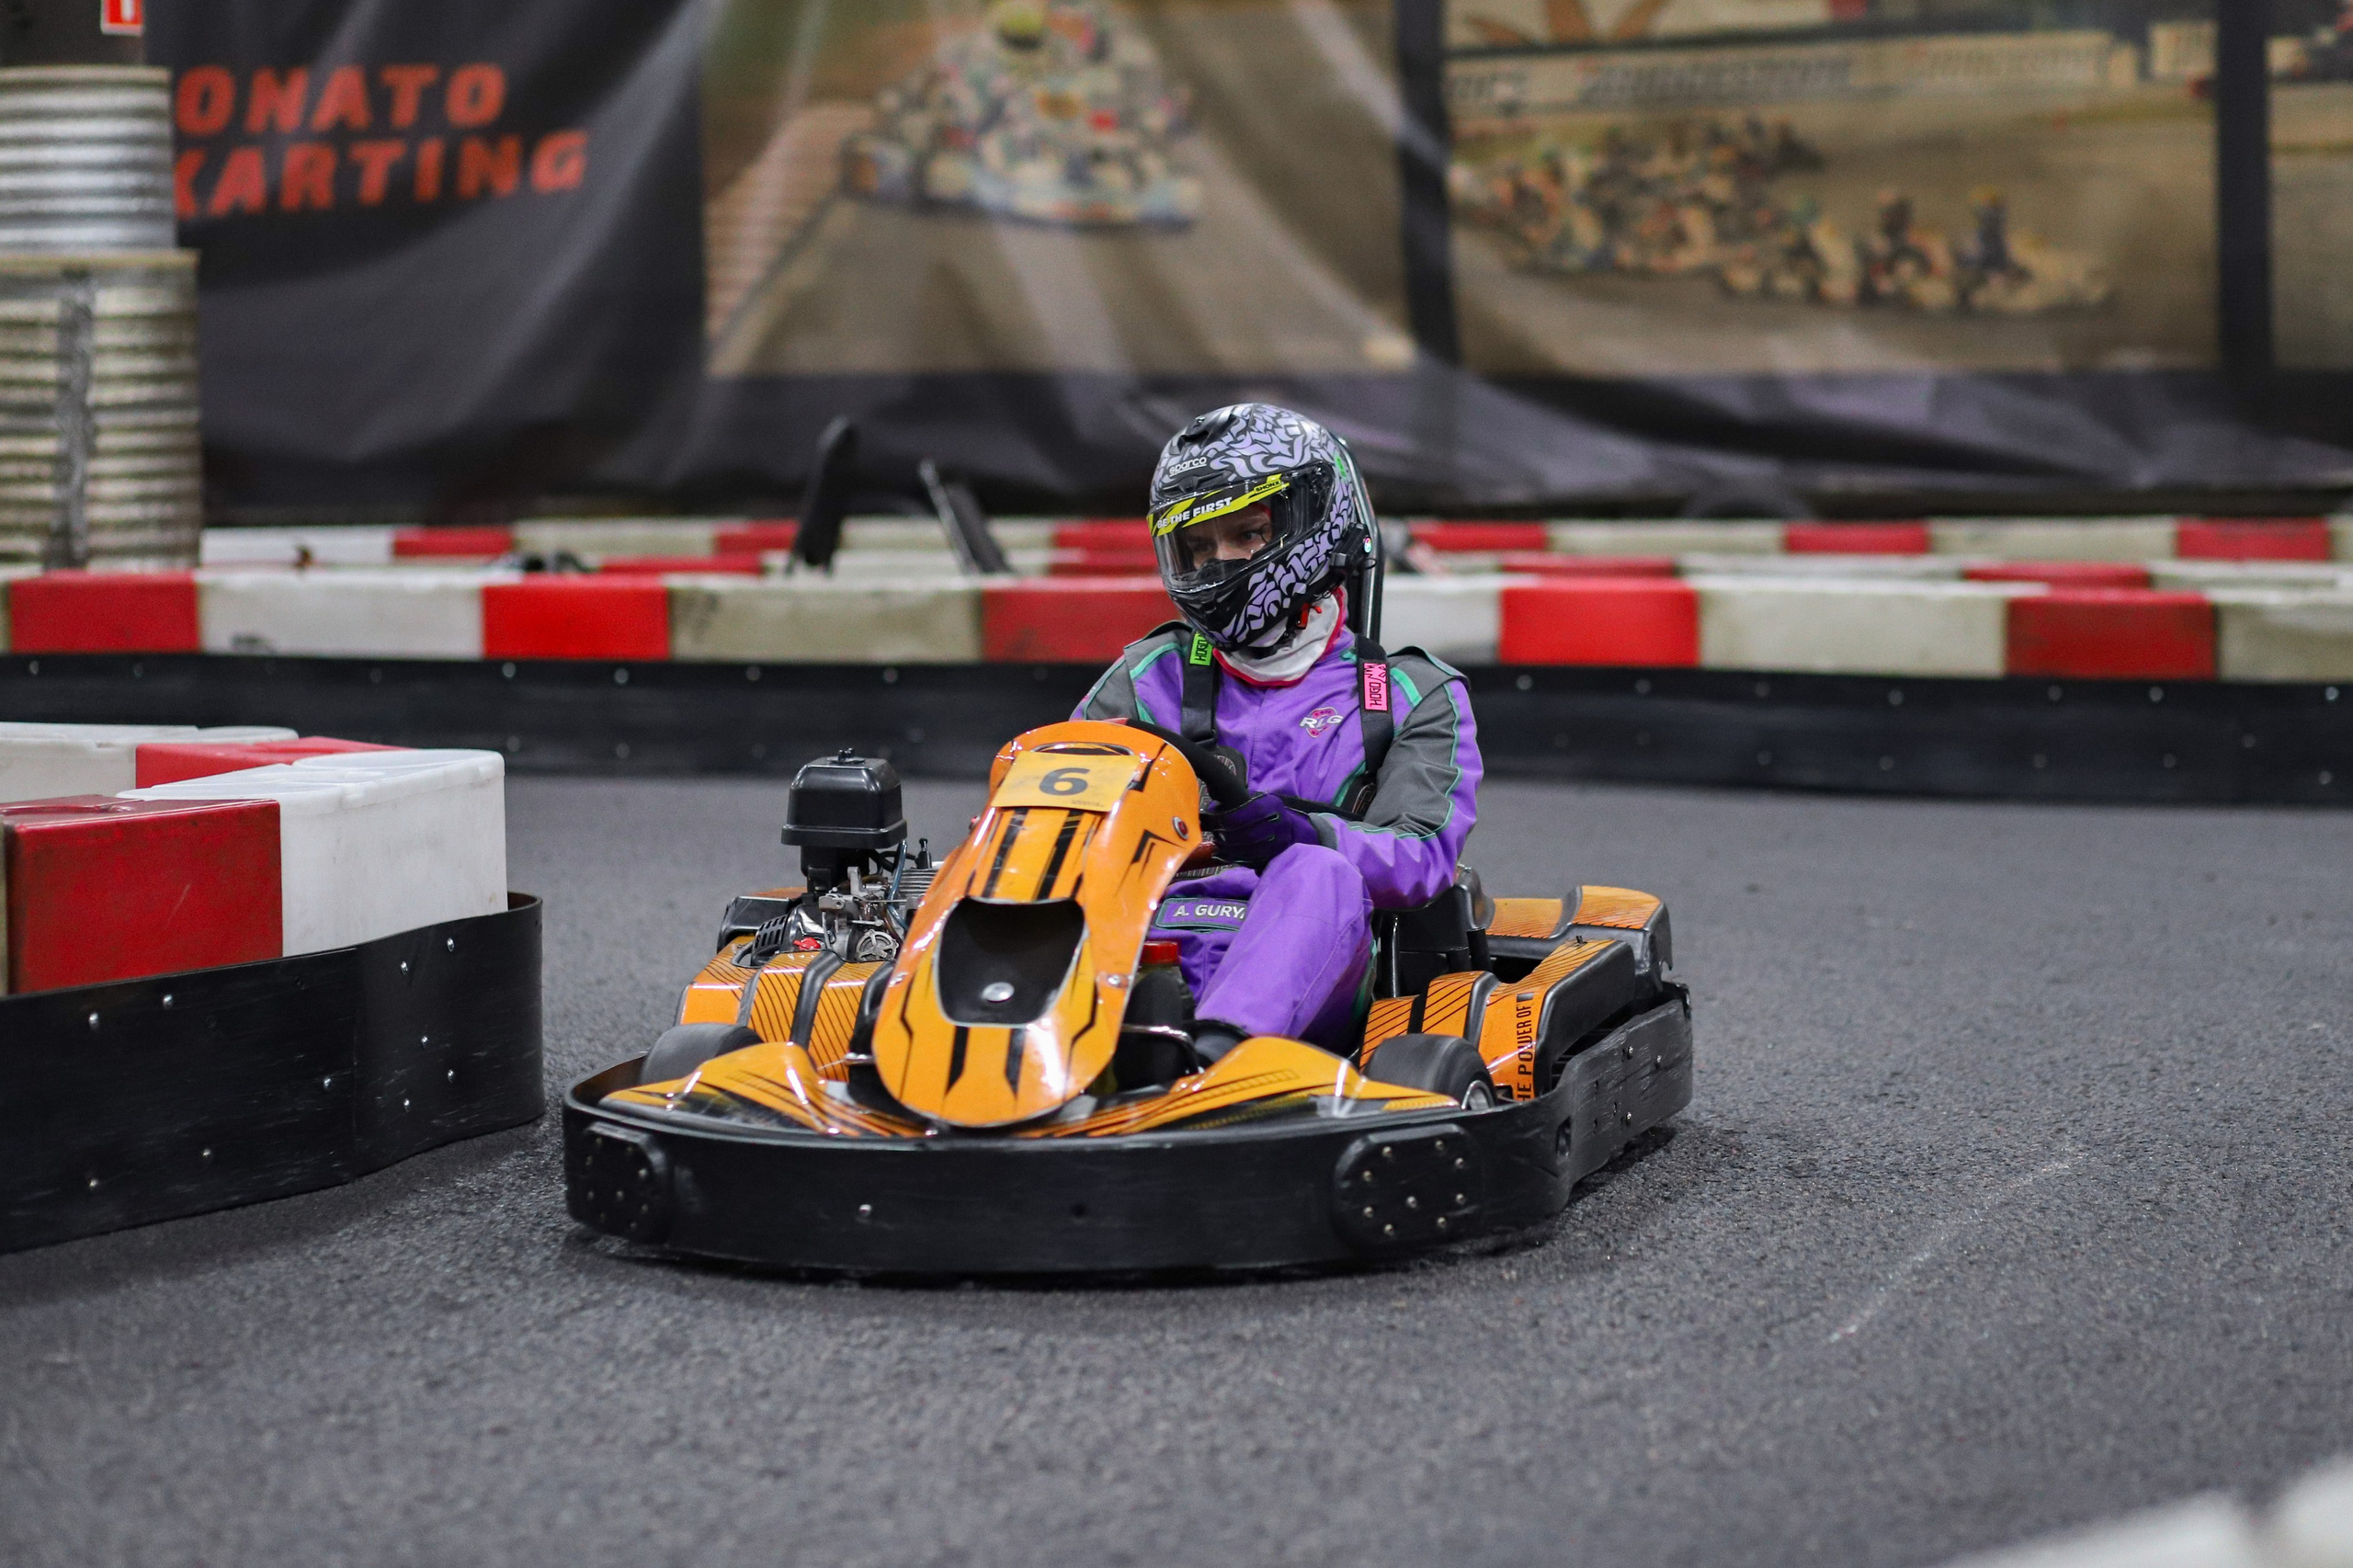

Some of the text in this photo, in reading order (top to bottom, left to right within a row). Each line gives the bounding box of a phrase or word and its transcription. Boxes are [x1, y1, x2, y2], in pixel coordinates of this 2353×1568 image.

[1169, 457, 1207, 476] sparco
[1156, 496, 1233, 529] BE THE FIRST
[1299, 714, 1344, 729] RLG
[1039, 767, 1091, 796] 6
[1173, 904, 1189, 917] A.
[1516, 1006, 1532, 1018] OF
[1516, 1019, 1534, 1075] POWER
